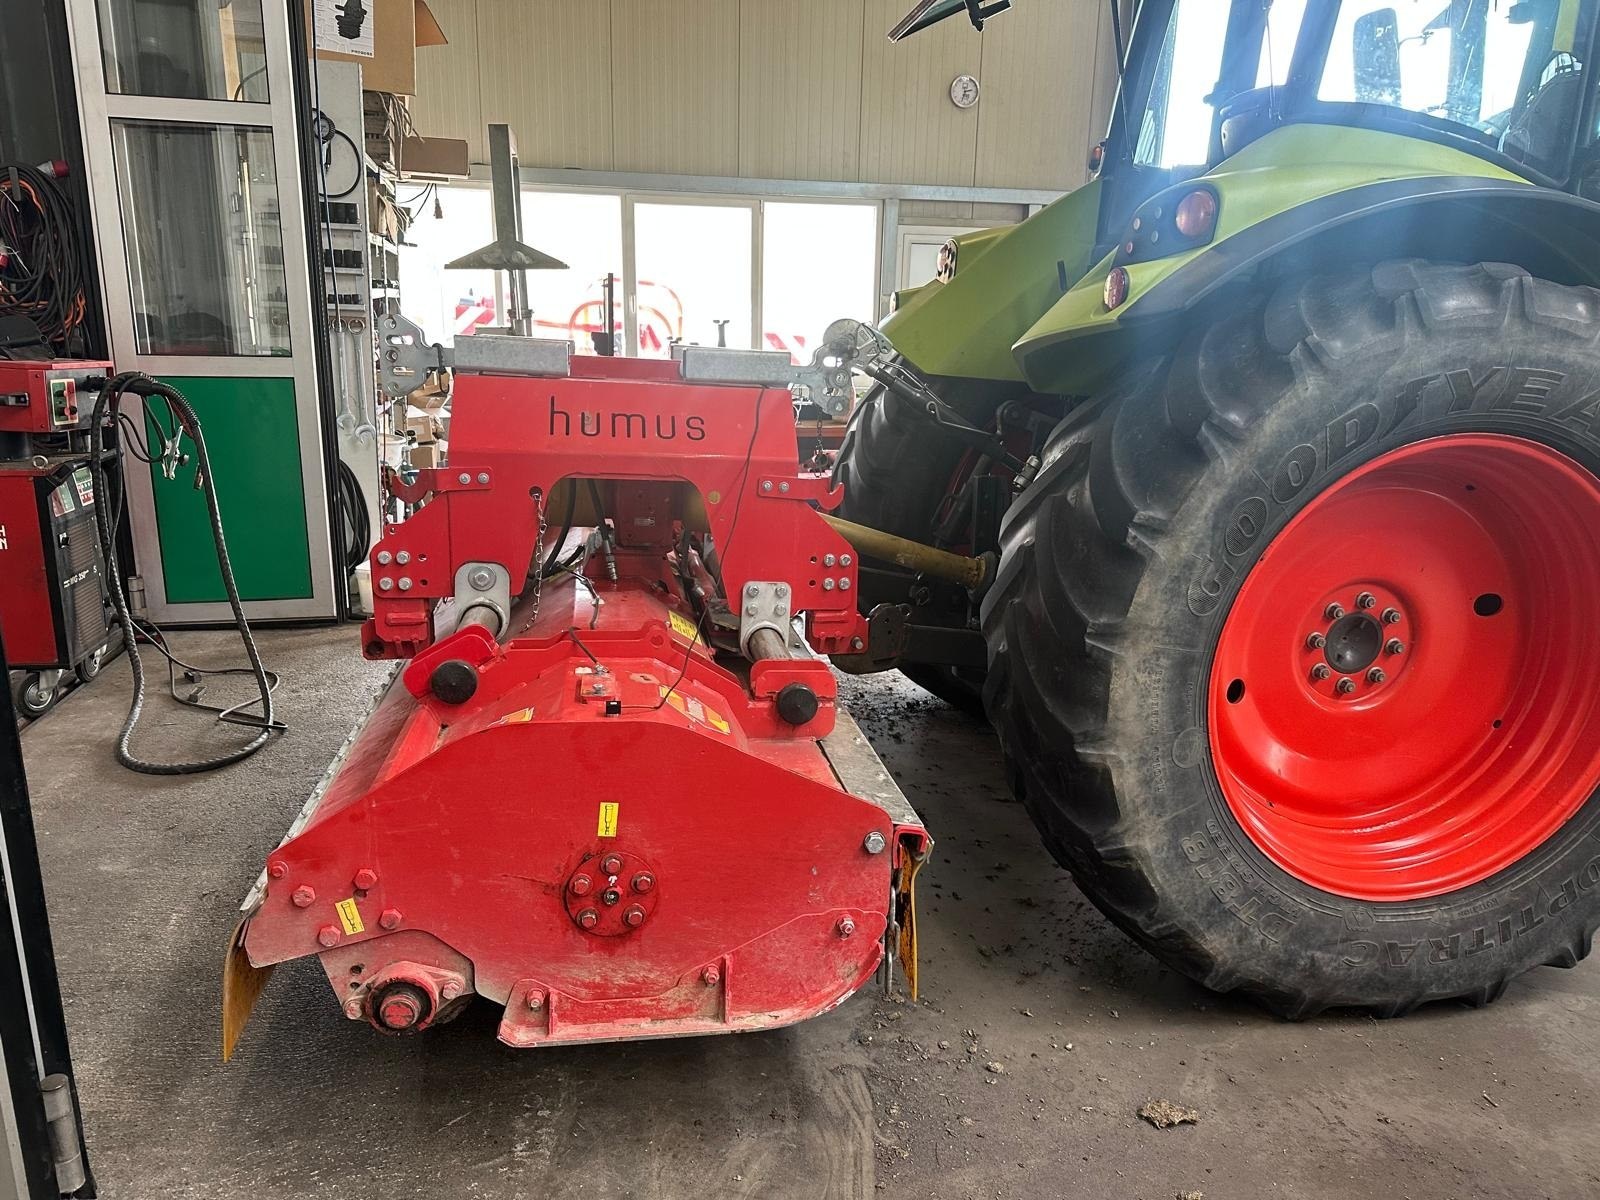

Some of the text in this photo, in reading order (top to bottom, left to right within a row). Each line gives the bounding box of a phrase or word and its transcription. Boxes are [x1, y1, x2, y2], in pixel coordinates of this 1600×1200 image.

[550, 397, 707, 440] humus
[1181, 831, 1297, 943] DT818
[1206, 819, 1302, 919] HIGH SPEED
[1342, 854, 1600, 968] OPTITRAC
